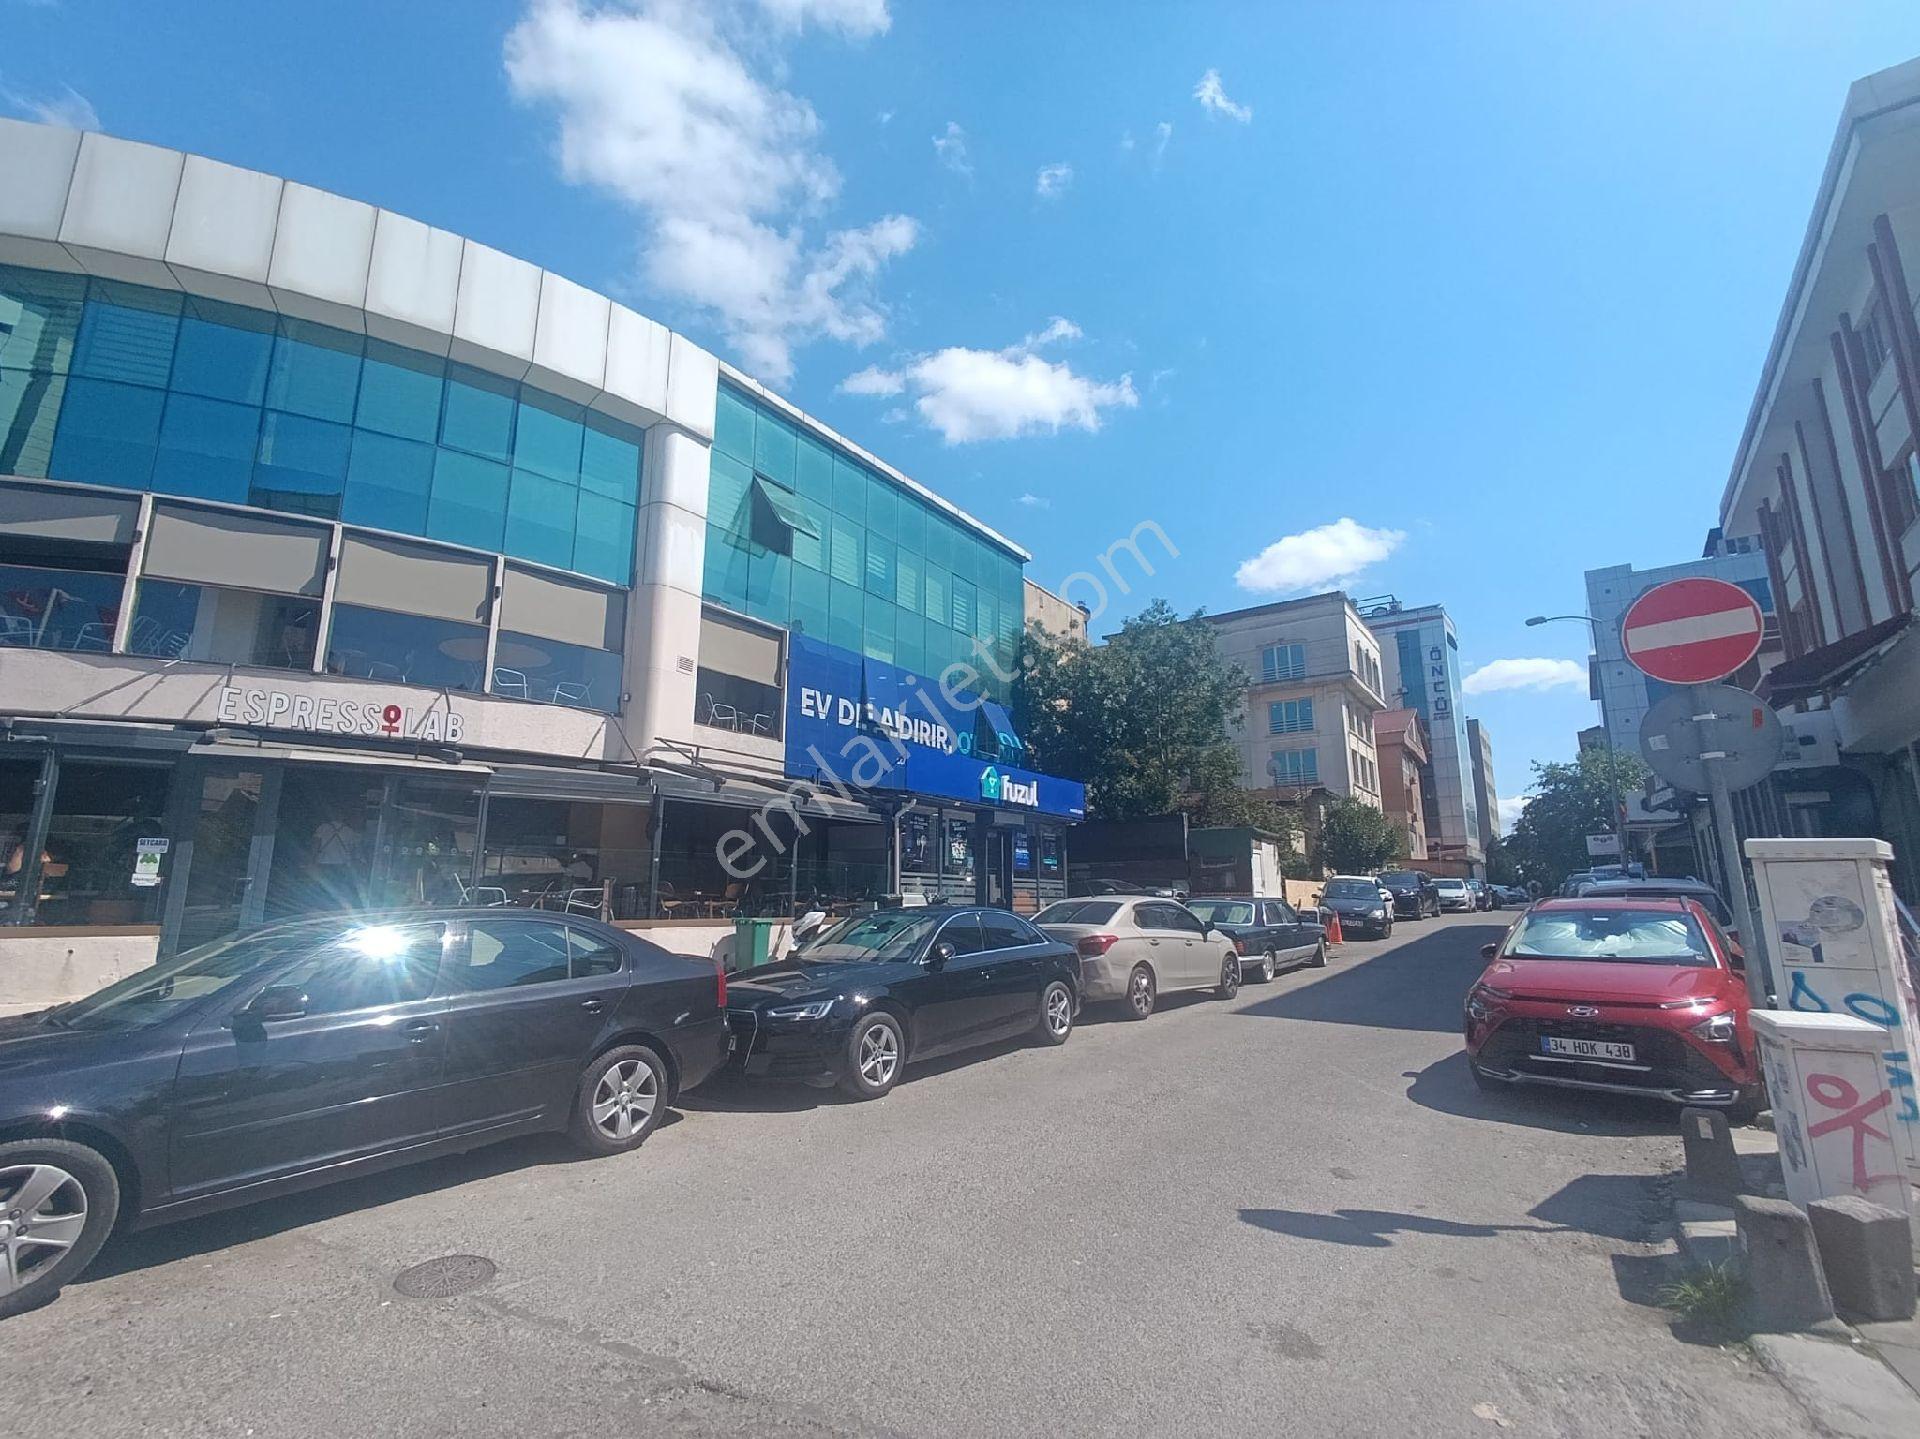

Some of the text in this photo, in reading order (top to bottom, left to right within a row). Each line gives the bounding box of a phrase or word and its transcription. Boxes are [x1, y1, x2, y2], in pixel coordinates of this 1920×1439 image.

[1430, 646, 1448, 711] ÖNCÜ
[801, 687, 833, 720] EV
[1001, 774, 1039, 808] fuzul
[1551, 1039, 1566, 1052] 34
[1573, 1041, 1598, 1055] HDK
[1605, 1044, 1630, 1058] 438
